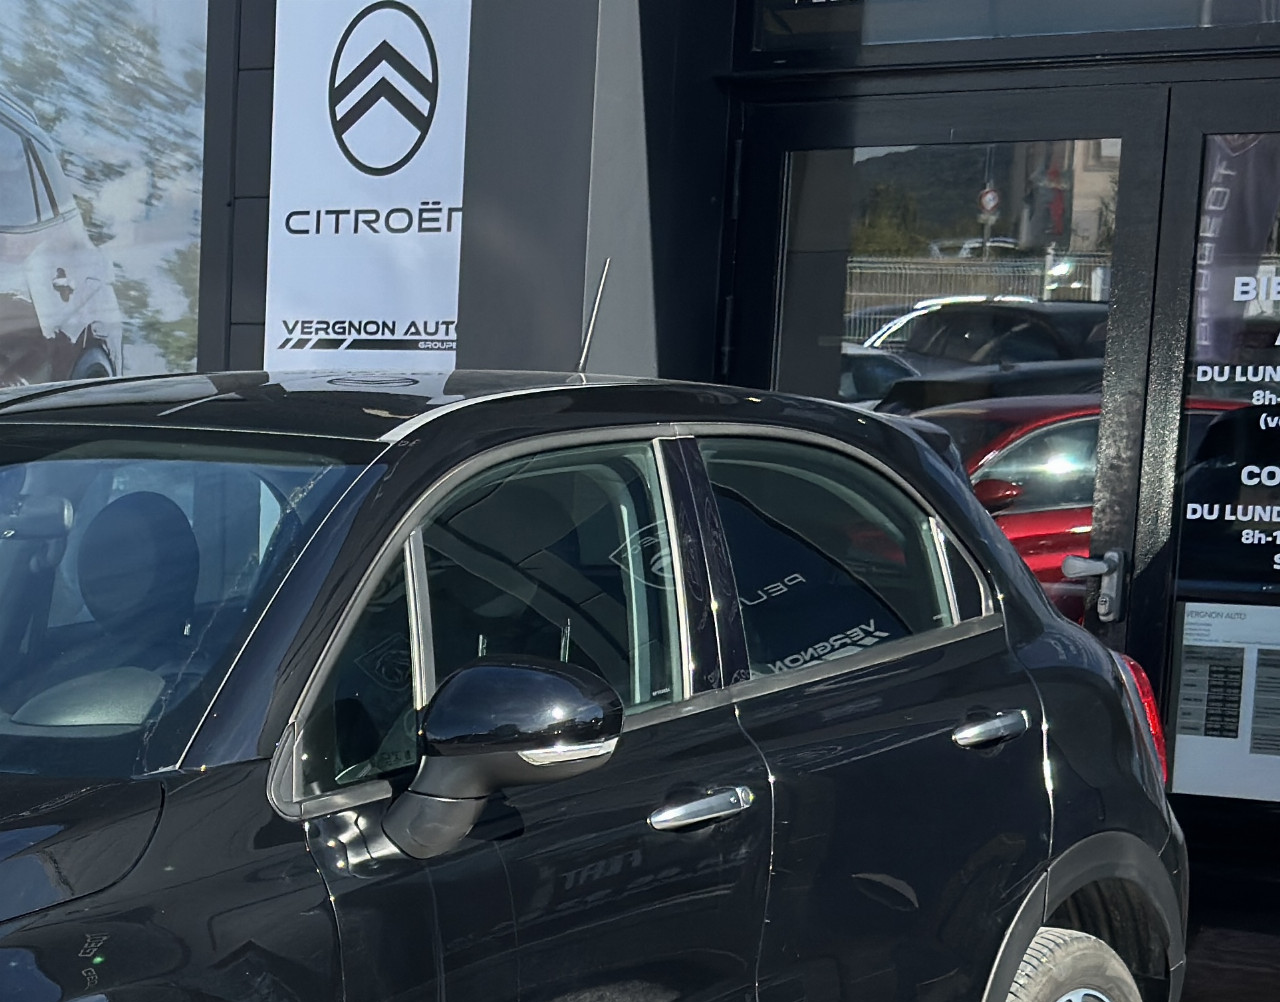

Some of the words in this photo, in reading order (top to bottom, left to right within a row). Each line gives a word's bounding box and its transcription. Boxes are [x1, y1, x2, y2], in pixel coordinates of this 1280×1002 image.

[281, 319, 396, 337] VERGNON
[403, 319, 458, 337] AUT
[1196, 365, 1231, 382] DU
[1186, 503, 1220, 521] DU
